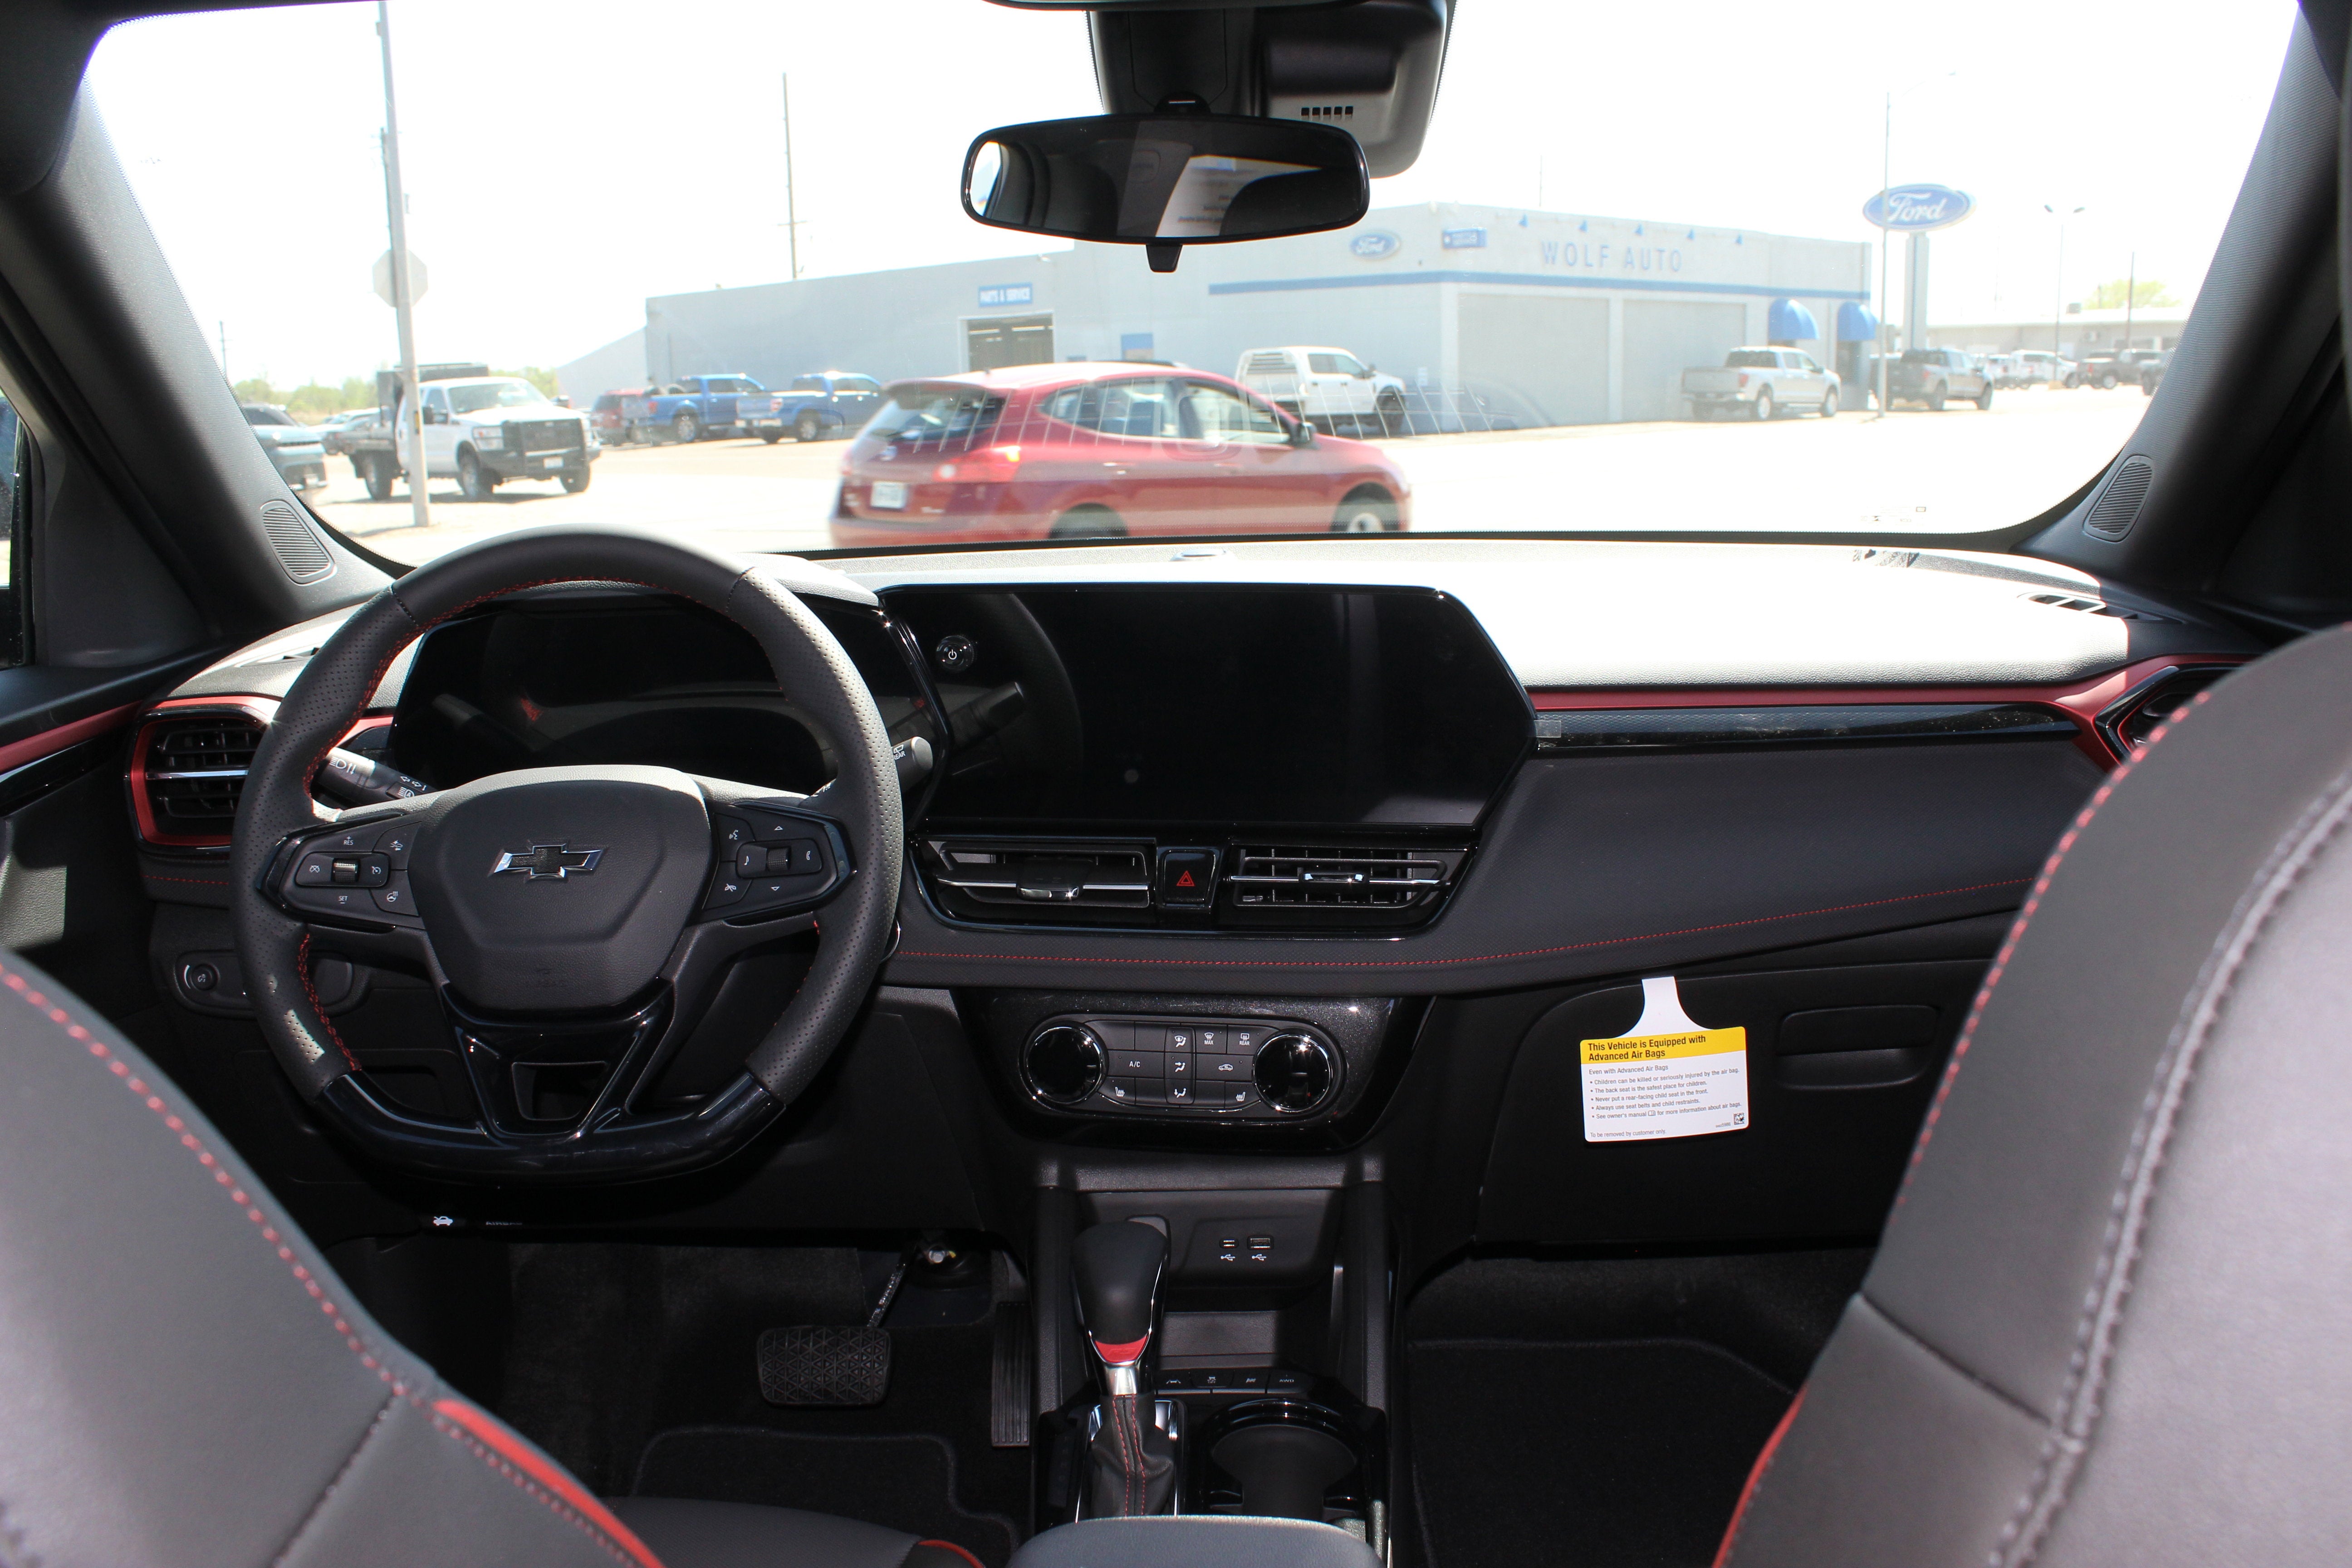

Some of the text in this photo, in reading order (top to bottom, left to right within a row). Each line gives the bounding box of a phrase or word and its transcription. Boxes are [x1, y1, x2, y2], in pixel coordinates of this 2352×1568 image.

[1887, 192, 1948, 222] Ford
[1356, 236, 1386, 254] Ford
[1541, 241, 1682, 272] WOLF AUTO
[1607, 1041, 1637, 1050] Vehicle
[1649, 1037, 1686, 1048] Equipped
[1689, 1035, 1706, 1044] with
[1589, 1052, 1629, 1061] Advanced
[1646, 1050, 1666, 1058] Bags
